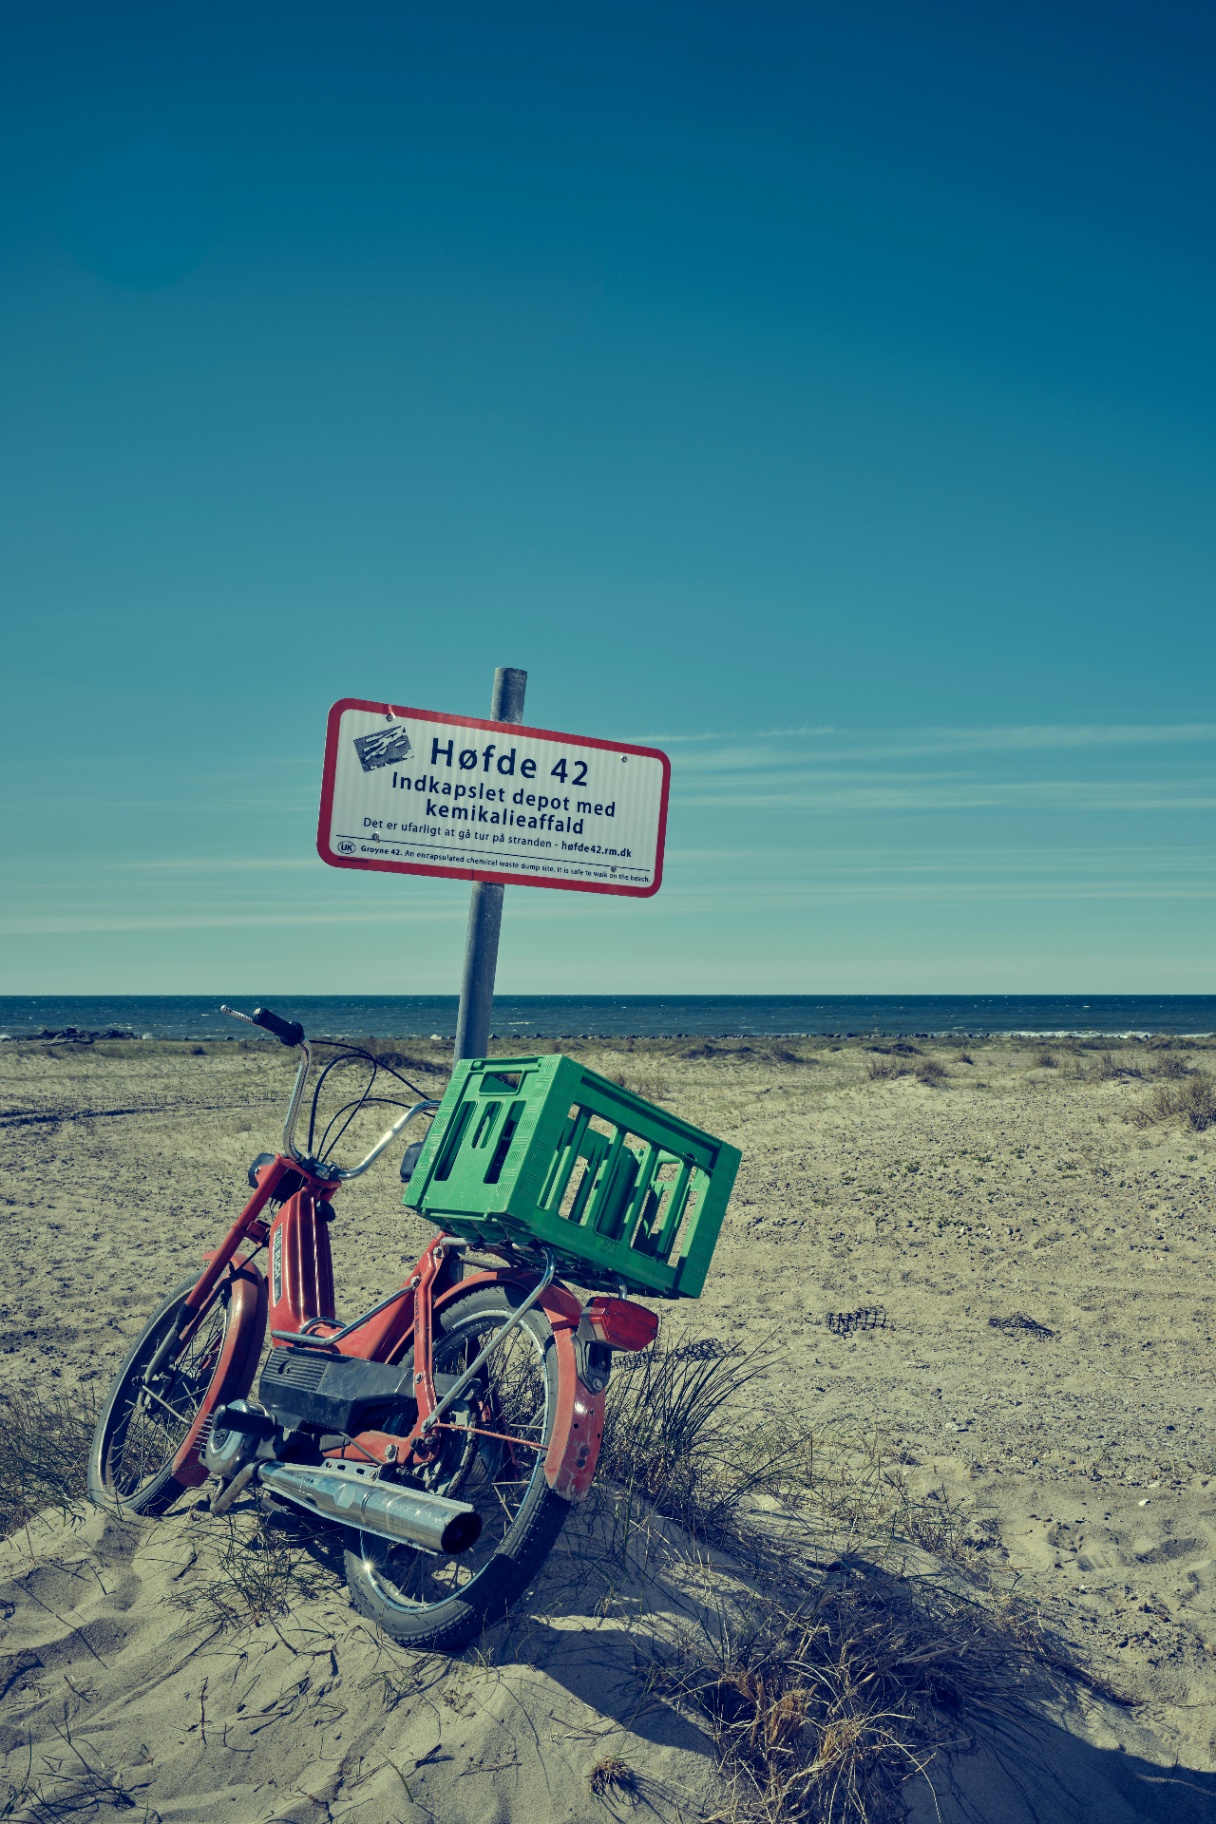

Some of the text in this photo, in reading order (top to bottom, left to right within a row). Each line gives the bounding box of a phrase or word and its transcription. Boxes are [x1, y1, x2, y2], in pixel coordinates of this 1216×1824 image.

[431, 738, 588, 787] Høfde 42
[392, 772, 616, 818] Indkapslet depot med
[426, 799, 584, 835] kemikalieaffald
[340, 843, 353, 852] UK
[363, 817, 383, 829] Det
[387, 821, 398, 830] er
[401, 823, 441, 837] ufarligt
[444, 828, 455, 837] at
[458, 829, 471, 841] gå
[474, 831, 489, 841] tur
[492, 833, 505, 844] på
[508, 836, 552, 848] stranden
[561, 841, 632, 858] høfde42.rm.dk
[360, 845, 389, 855] Groyne
[391, 848, 403, 856] 42.
[416, 852, 465, 863] encapsulated
[466, 856, 498, 866] chemical
[521, 863, 540, 871] dump
[570, 868, 584, 876] safe
[593, 870, 608, 878] walk
